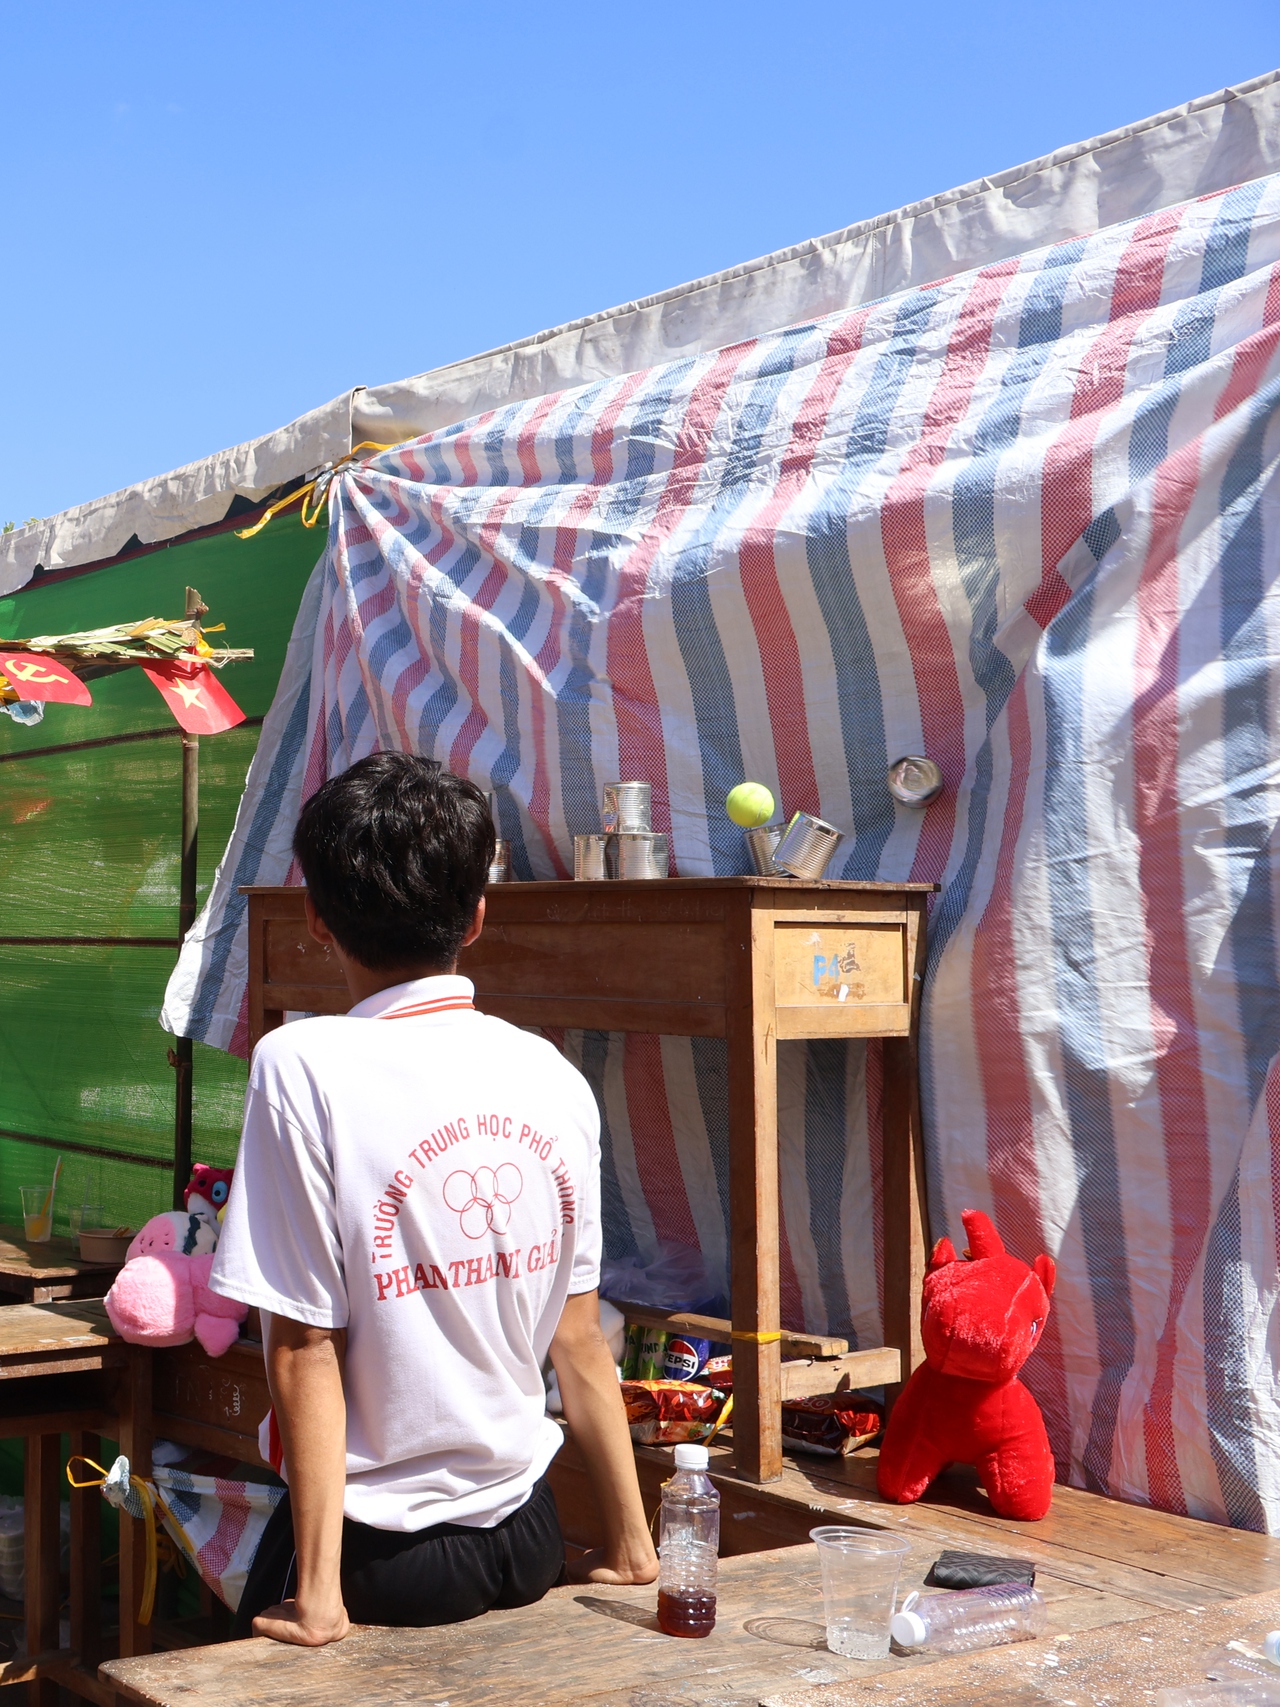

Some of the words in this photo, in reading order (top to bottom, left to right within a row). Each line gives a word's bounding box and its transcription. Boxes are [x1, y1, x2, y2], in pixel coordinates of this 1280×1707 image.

[372, 1169, 414, 1264] TRƯỜNG
[408, 1117, 470, 1169] TRUNG
[476, 1114, 513, 1142] HỌC
[519, 1123, 559, 1161] PHỔ
[551, 1157, 577, 1226] THÔNG
[374, 1262, 449, 1301] PHAN
